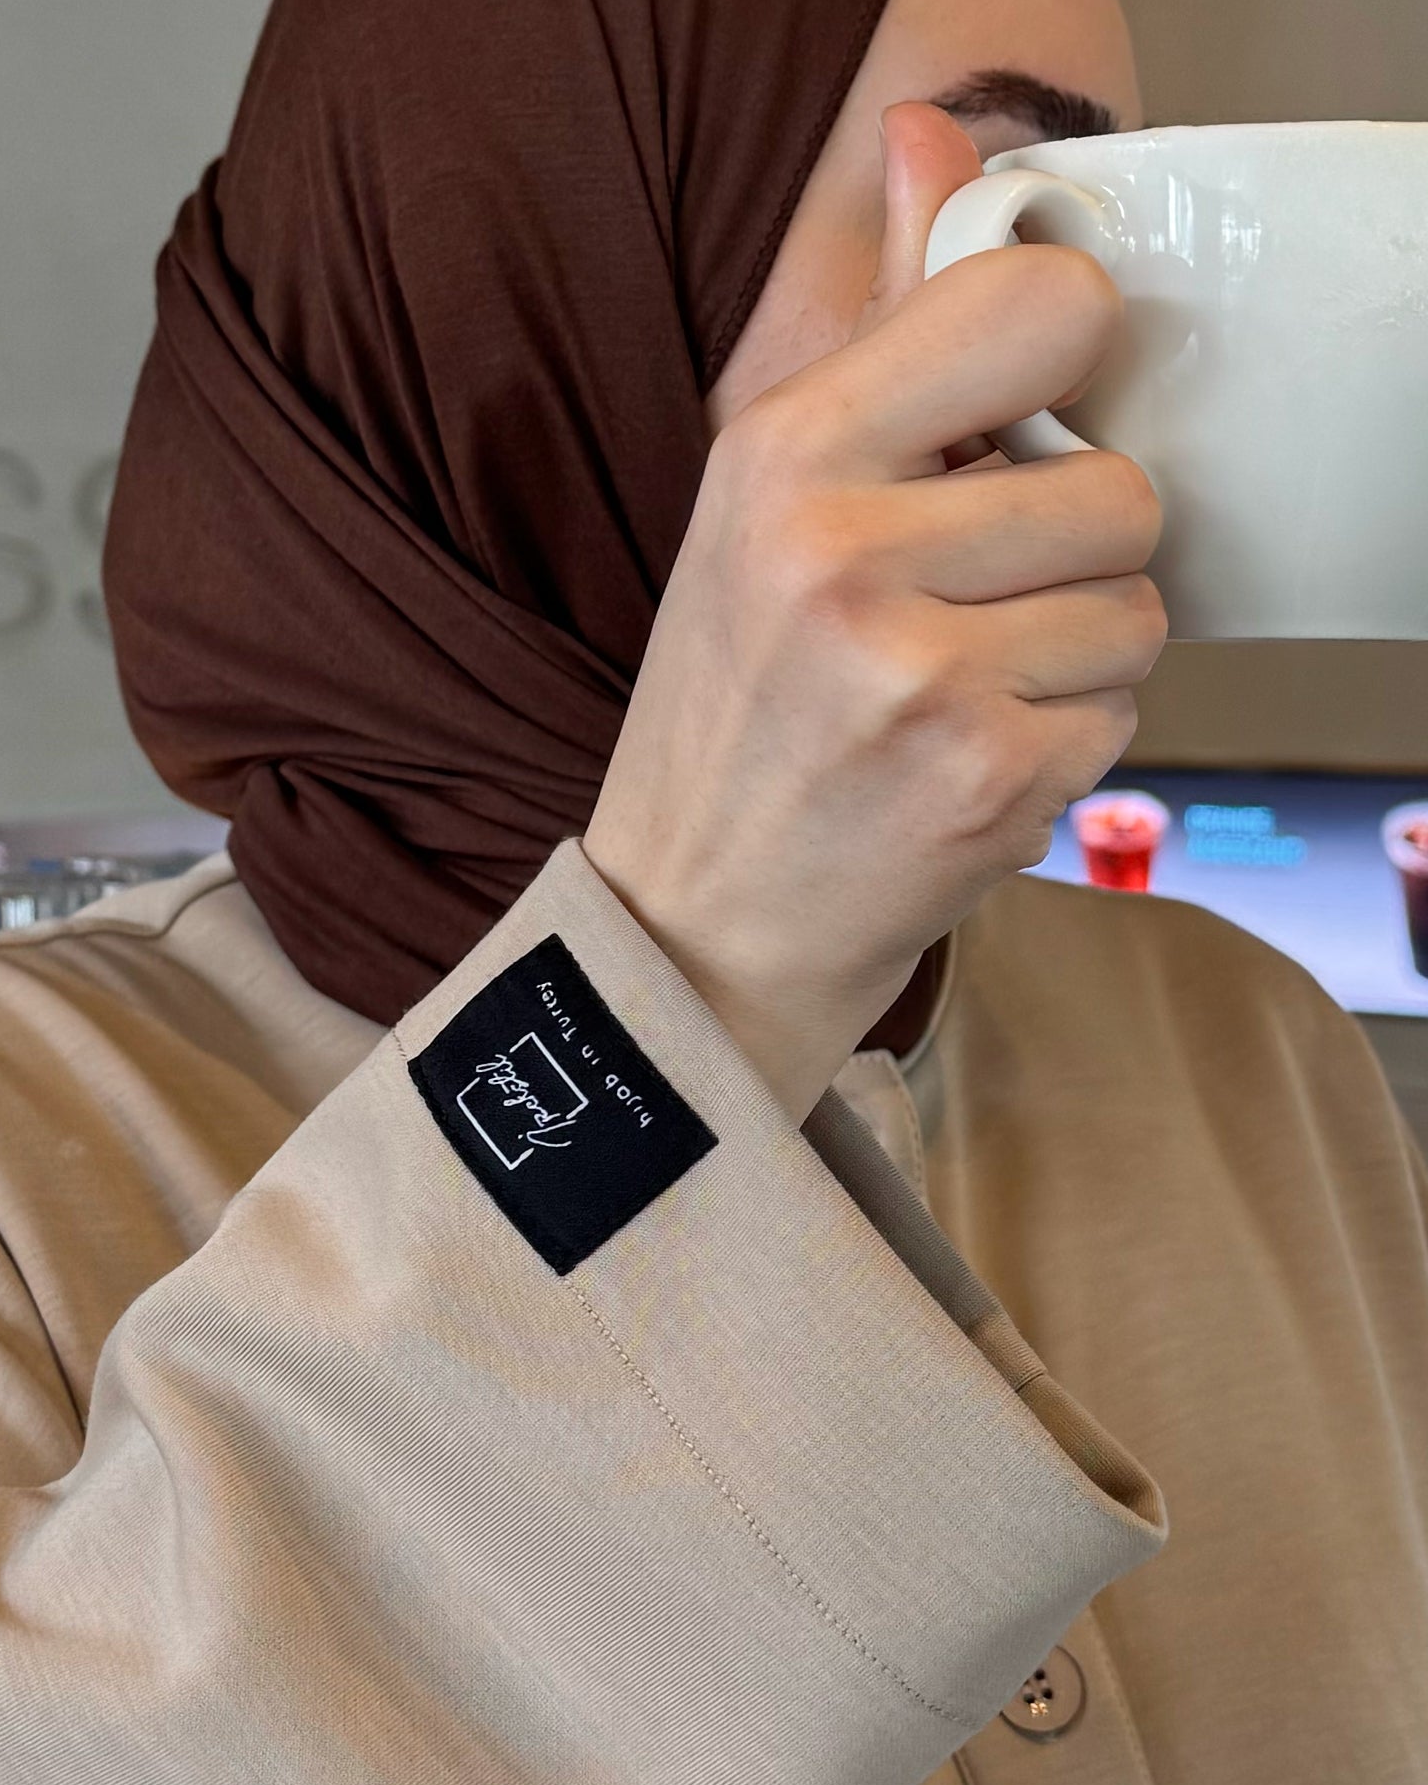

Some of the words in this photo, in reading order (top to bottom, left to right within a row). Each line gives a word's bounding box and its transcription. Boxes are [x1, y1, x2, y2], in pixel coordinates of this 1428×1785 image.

[536, 981, 576, 1042] Turkey
[581, 1044, 601, 1066] in
[605, 1074, 654, 1128] hijab
